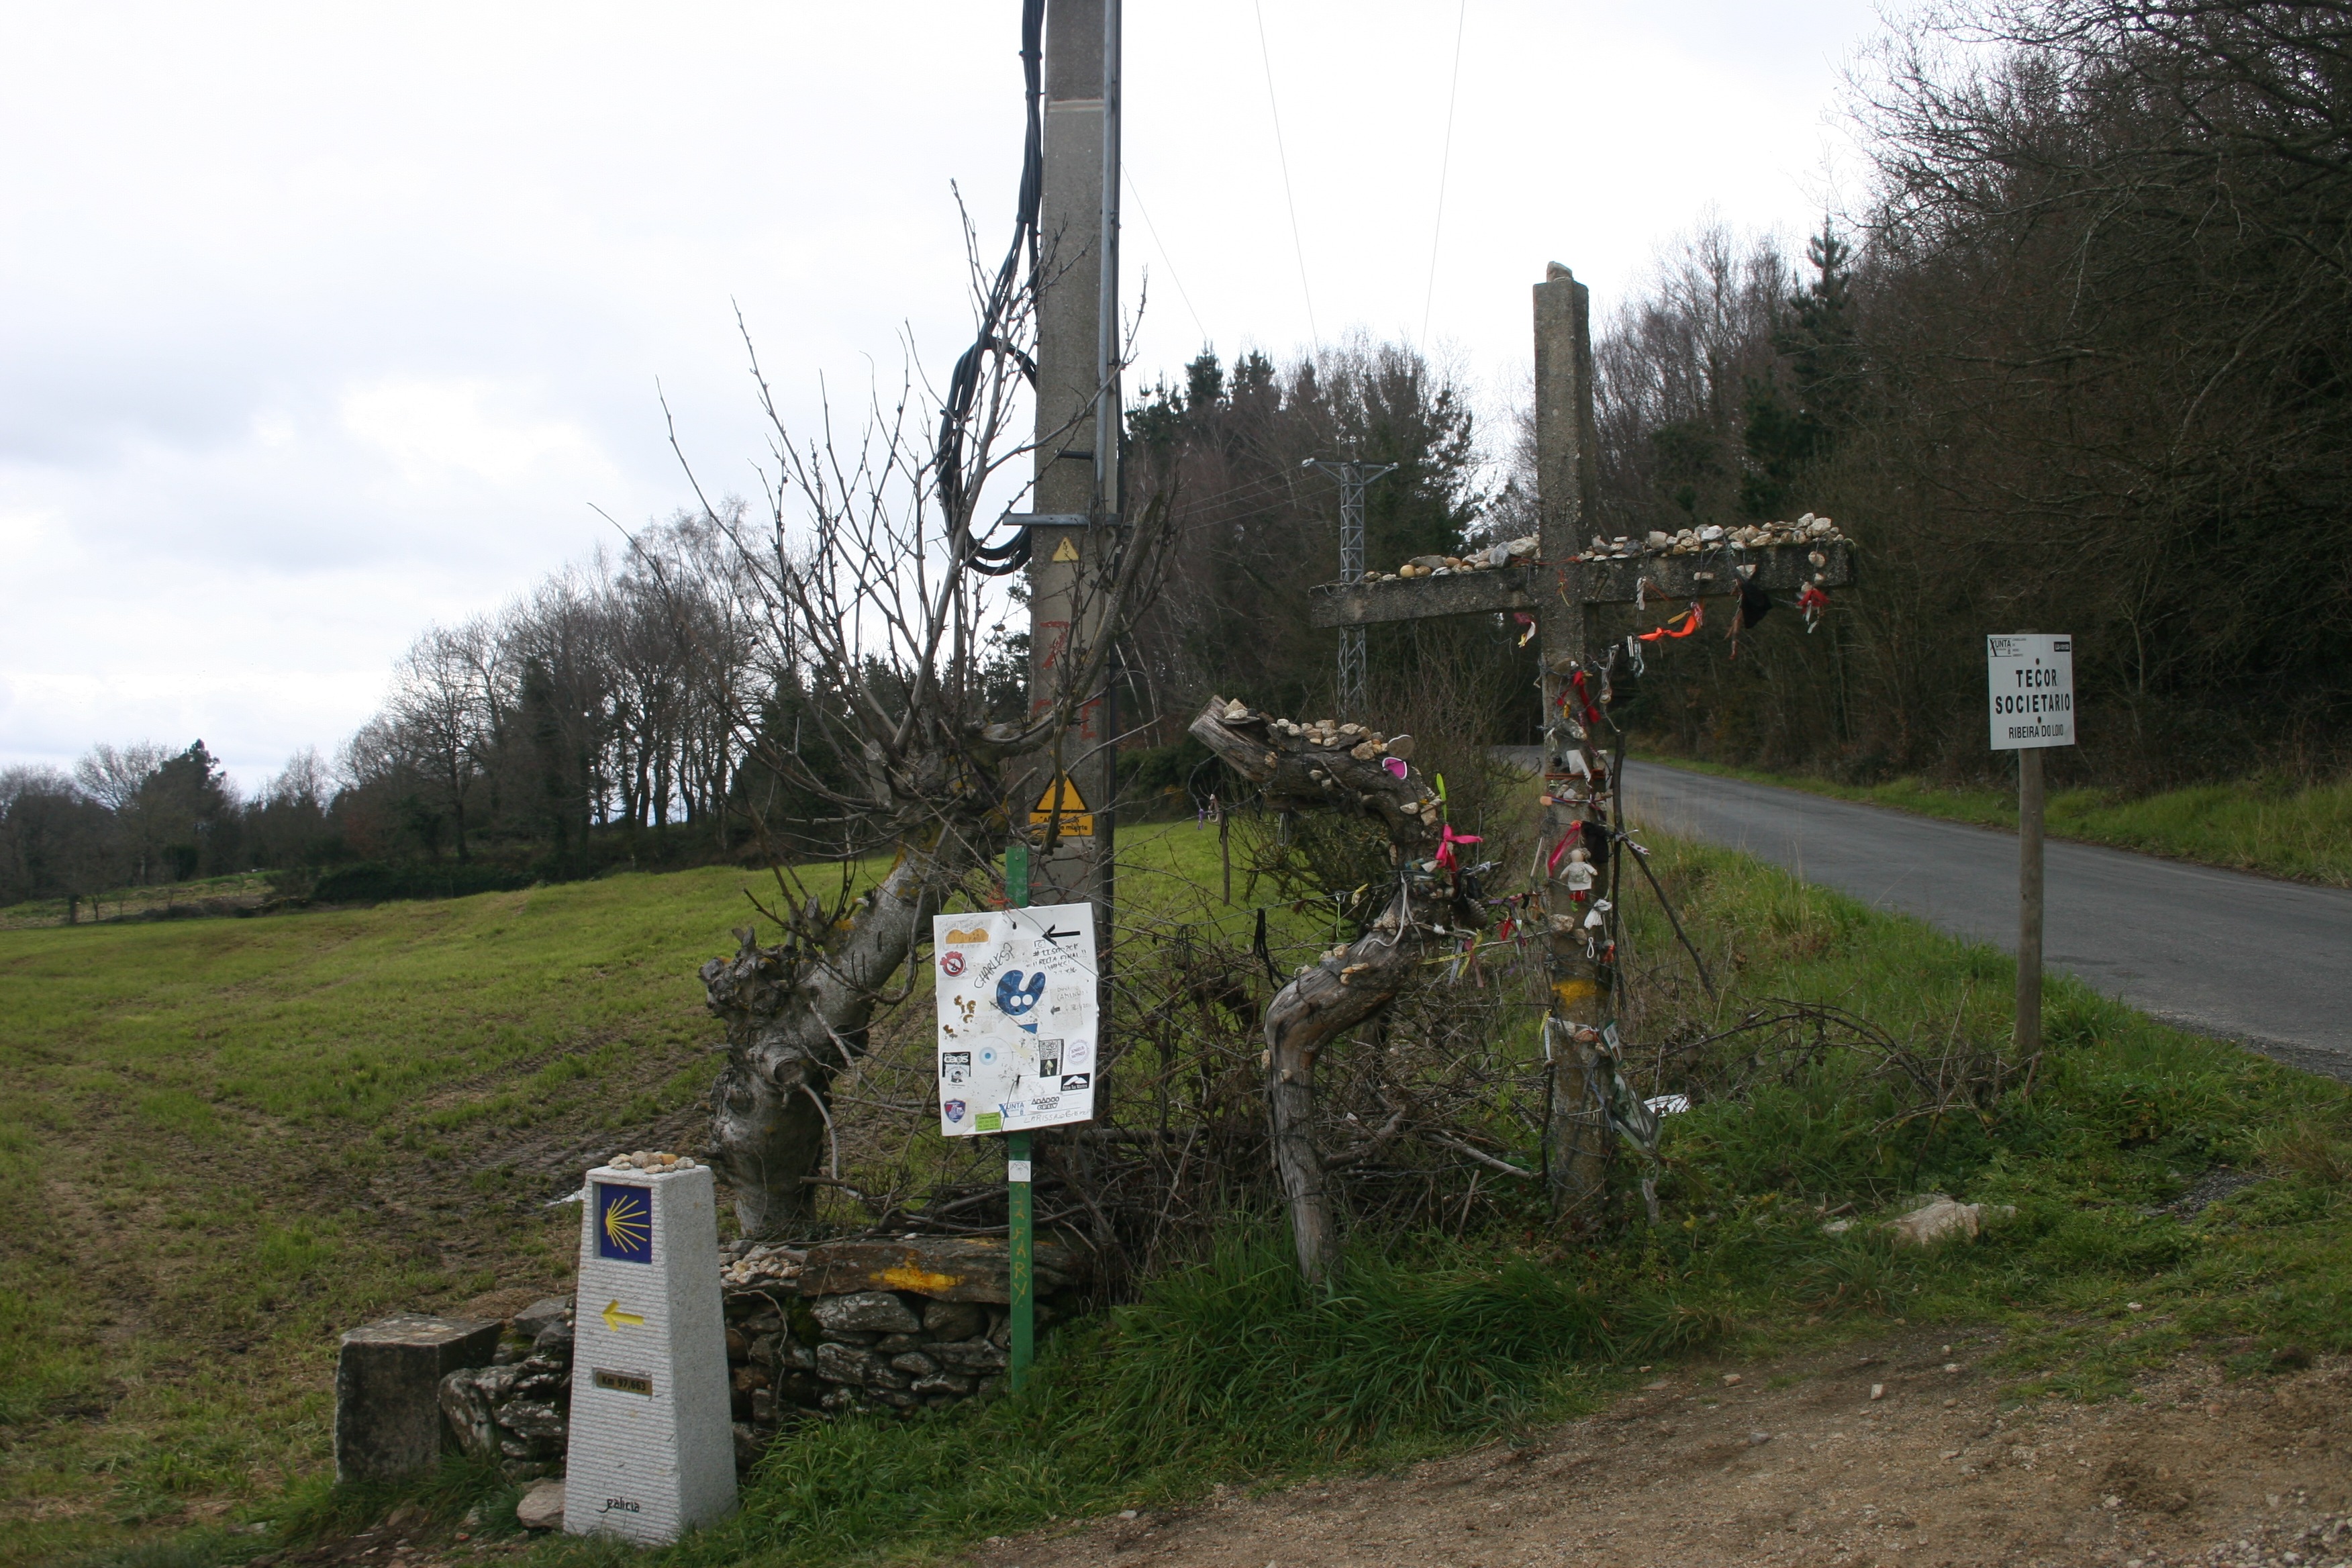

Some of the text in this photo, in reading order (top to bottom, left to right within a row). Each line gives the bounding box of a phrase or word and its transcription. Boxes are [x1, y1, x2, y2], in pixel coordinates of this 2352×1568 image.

[2016, 669, 2057, 687] TECOR
[1996, 693, 2070, 714] SOCIETARIO
[2009, 726, 2039, 738] RIBEIRA
[2041, 725, 2051, 737] DO
[602, 1375, 614, 1385] Km
[595, 1497, 640, 1513] galicia
